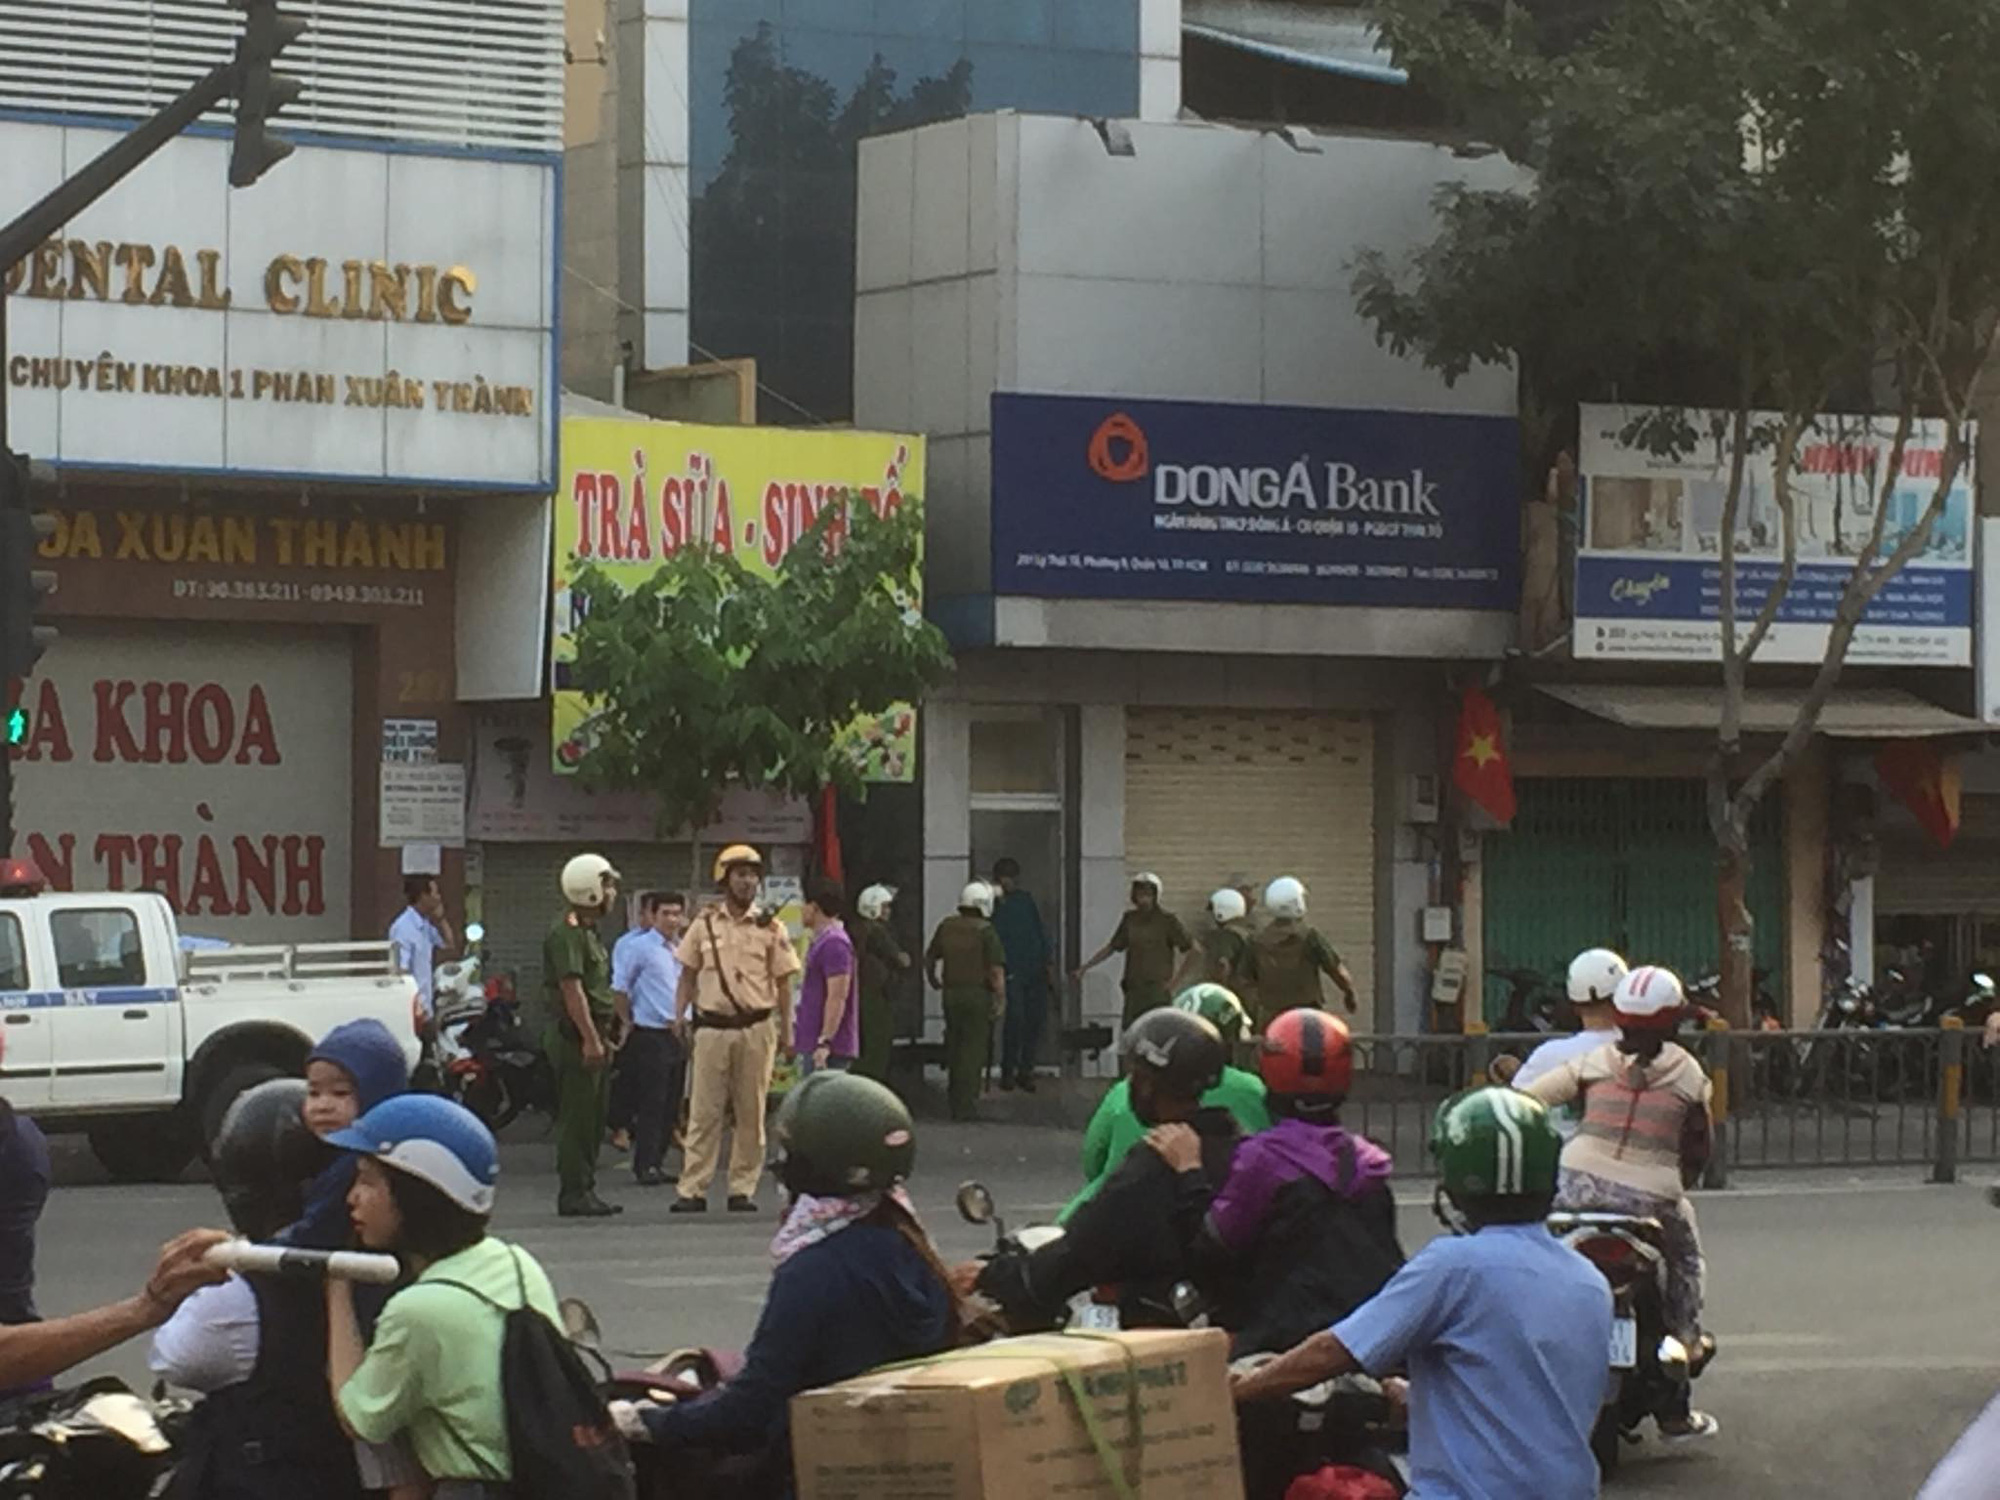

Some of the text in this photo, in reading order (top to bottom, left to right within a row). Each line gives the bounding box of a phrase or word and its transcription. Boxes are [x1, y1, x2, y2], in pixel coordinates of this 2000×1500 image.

[264, 254, 477, 325] CLINIC
[9, 351, 533, 416] CHUYÊN KHOA 1 PHAN XUÂN THÀNH
[660, 453, 733, 560] SỮA
[1324, 462, 1440, 517] Bank
[93, 679, 281, 765] KHOA
[95, 802, 325, 916] THÀNH
